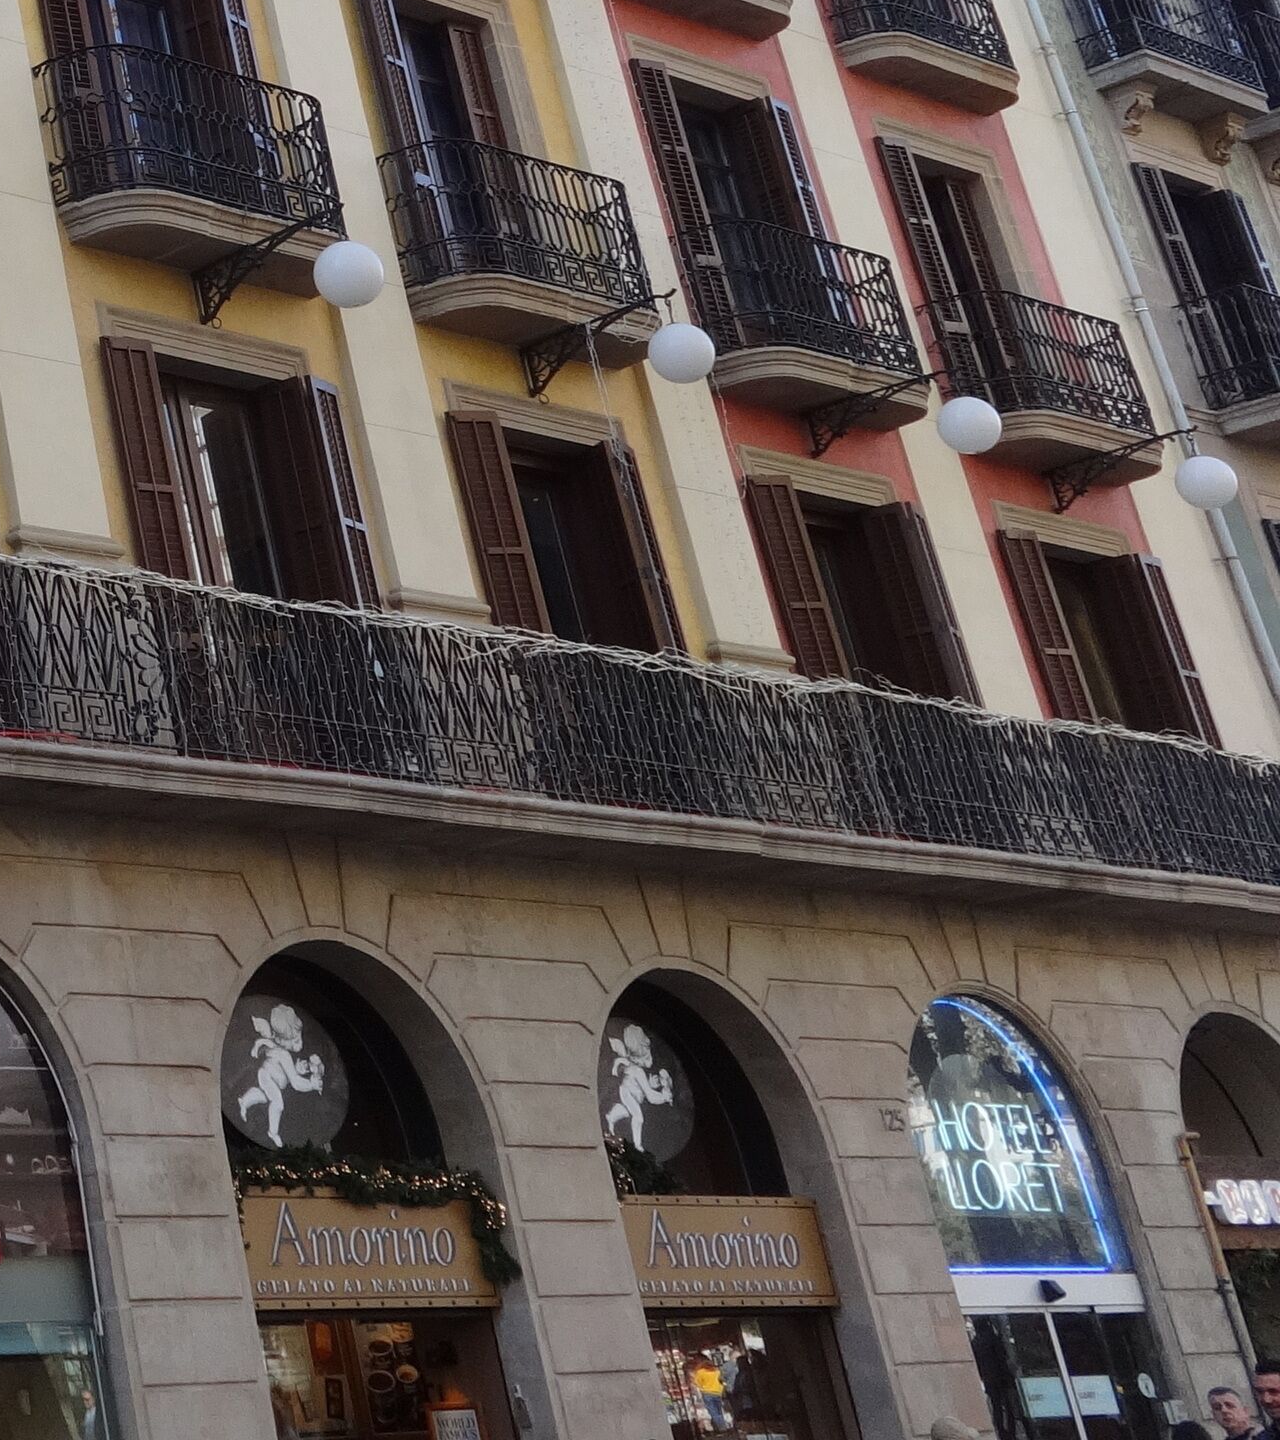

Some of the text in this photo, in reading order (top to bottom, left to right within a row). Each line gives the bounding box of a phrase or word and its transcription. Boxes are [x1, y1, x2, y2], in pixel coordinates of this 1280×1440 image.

[930, 1099, 1054, 1155] HOTEL
[941, 1159, 1067, 1212] LLORET
[269, 1201, 456, 1267] Amorino
[646, 1209, 801, 1269] Amorino
[256, 1279, 336, 1294] GELATO
